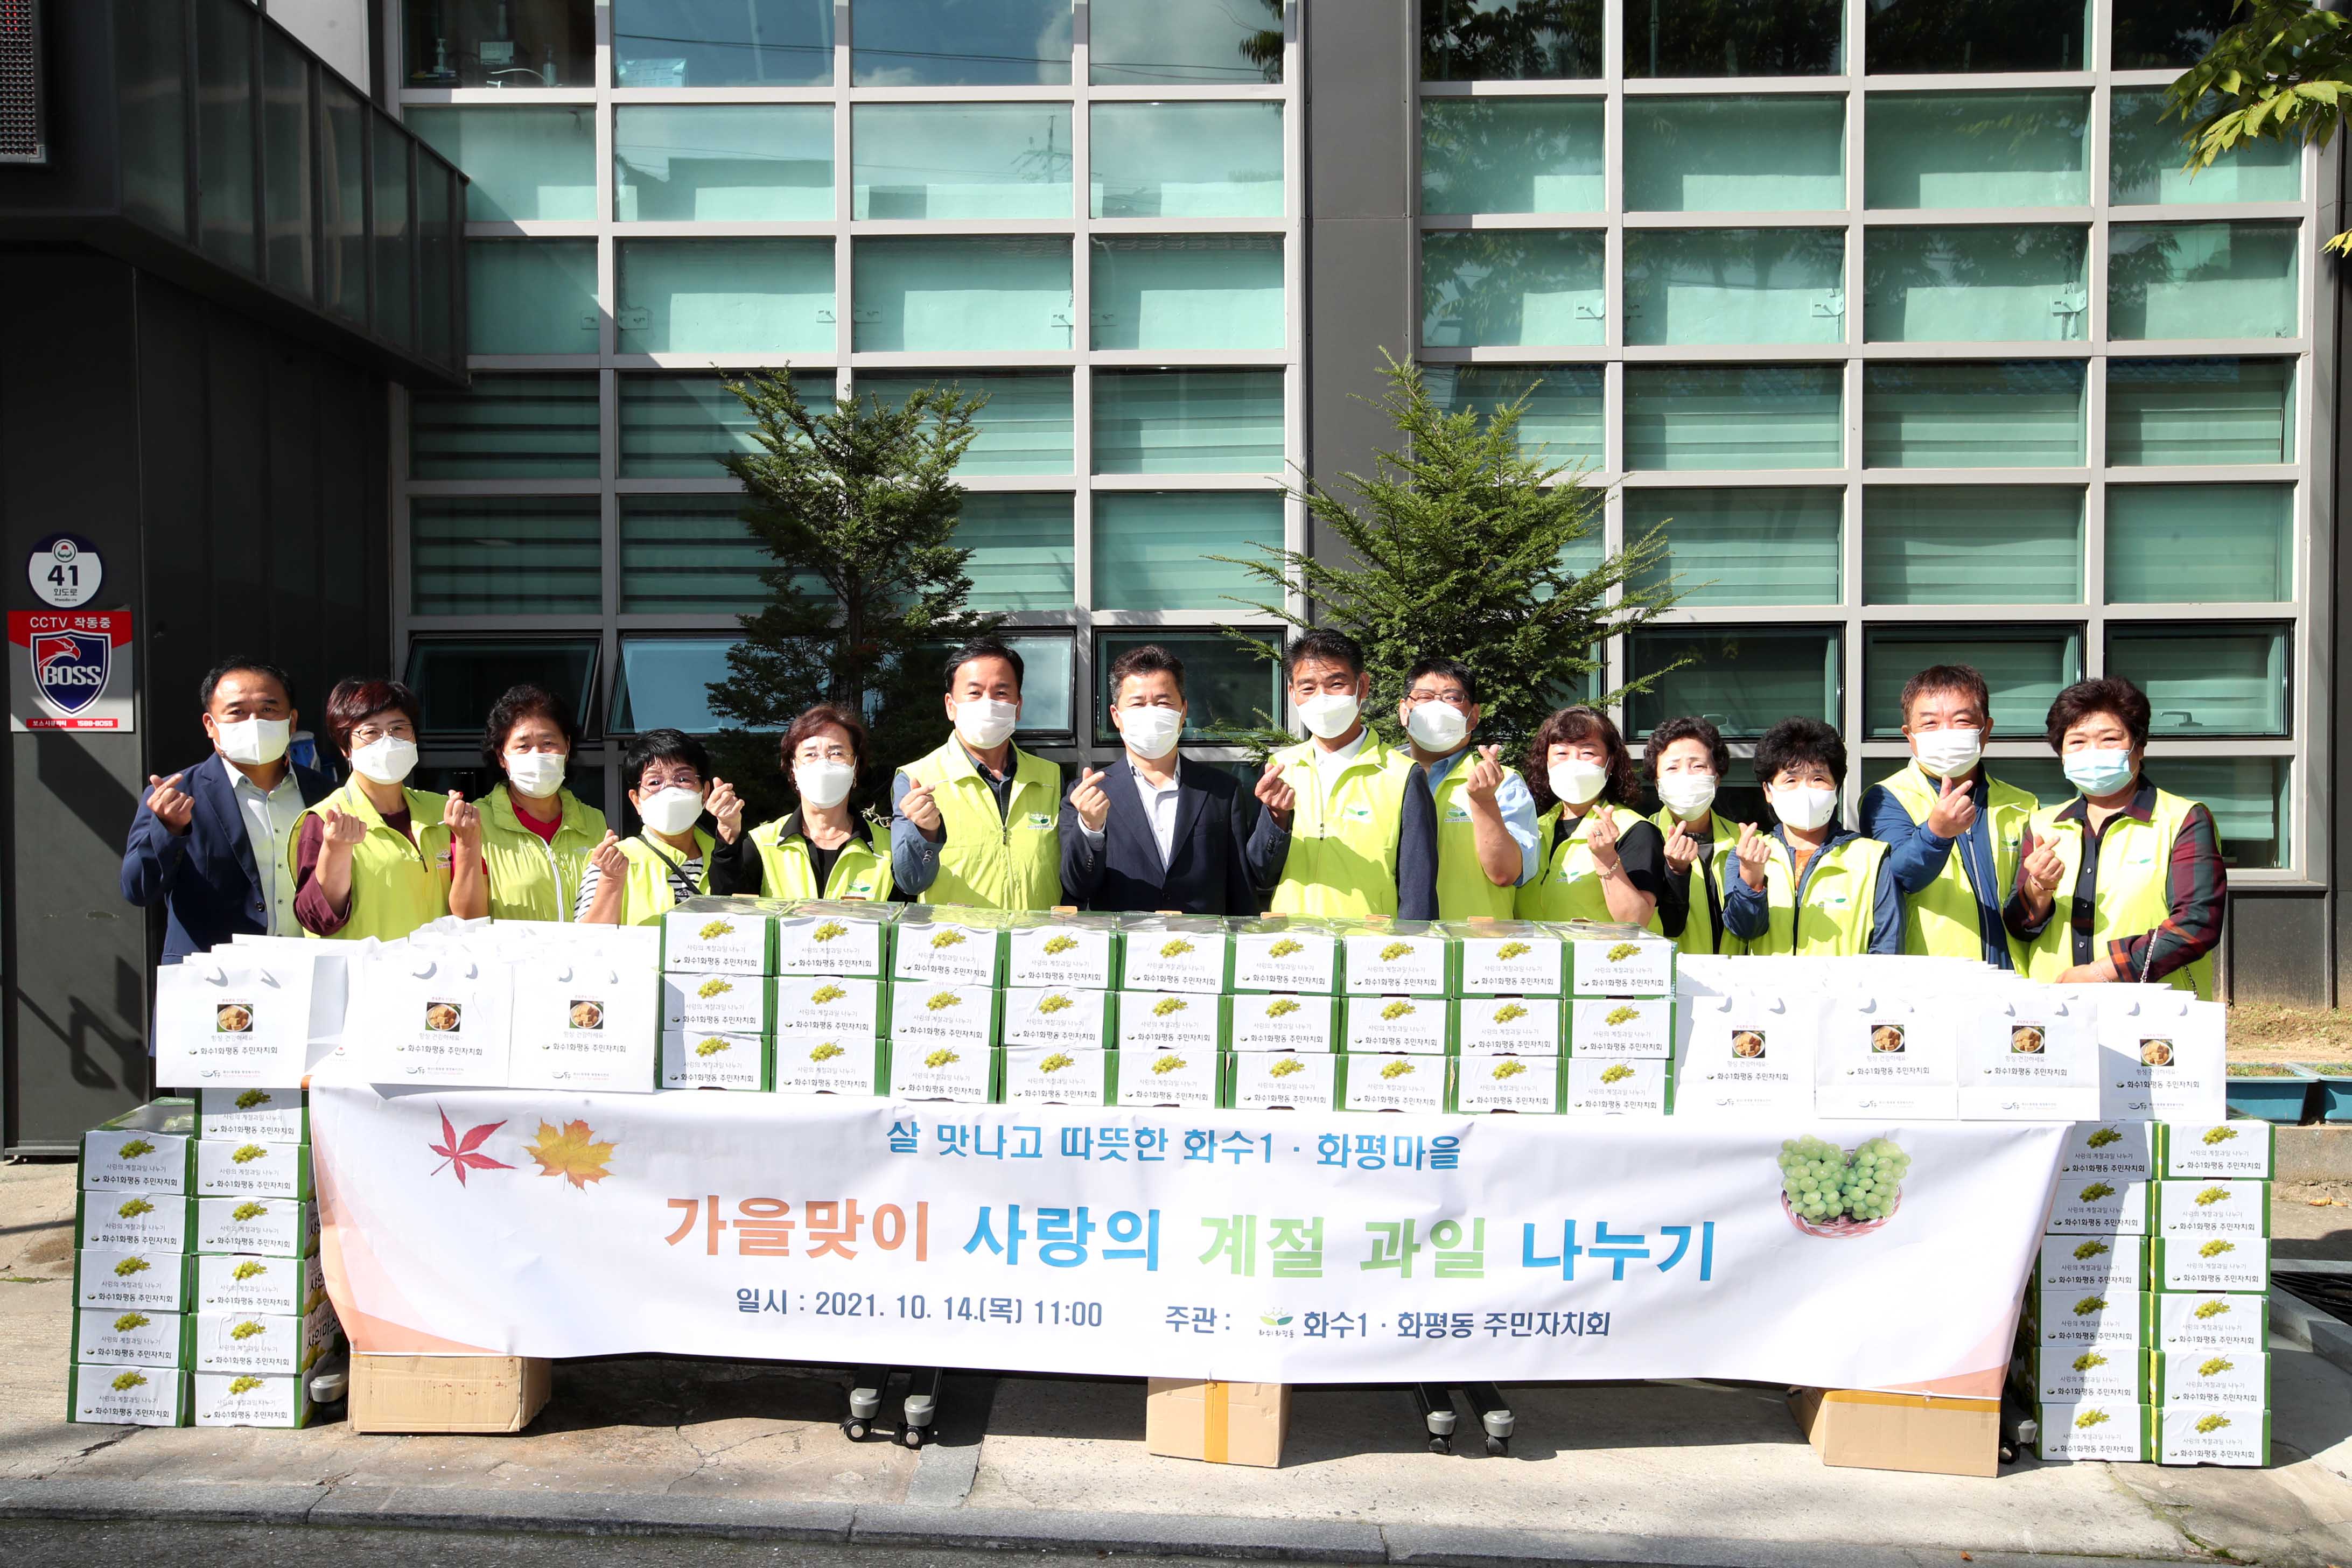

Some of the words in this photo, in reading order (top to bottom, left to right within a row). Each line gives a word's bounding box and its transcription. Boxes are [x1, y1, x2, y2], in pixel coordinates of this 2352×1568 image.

[47, 565, 78, 586] 41
[30, 617, 68, 628] CCTV
[74, 617, 111, 628] 작동중
[43, 666, 101, 685] BOSS
[723, 958, 757, 968] 주민자치회
[838, 960, 872, 968] 주민자치회
[953, 967, 986, 978] 주민자치회
[1067, 972, 1101, 982] 주민자치회
[1182, 976, 1216, 986] 주민자치회
[1292, 976, 1325, 985] 주민자치회
[1404, 978, 1437, 987] 주민자치회
[1520, 977, 1553, 986] 주민자치회
[1630, 979, 1664, 988] 주민자치회
[242, 1046, 277, 1055] 주민자치회
[447, 1046, 482, 1056] 주민자치회
[593, 1044, 626, 1053] 주민자치회
[1896, 1067, 1929, 1075] 주민자치회
[2033, 1068, 2067, 1076] 주민자치회
[720, 1074, 754, 1083] 주민자치회
[1755, 1073, 1788, 1081] 주민자치회
[834, 1080, 867, 1089] 주민자치회
[2166, 1081, 2200, 1089] 주민자치회
[947, 1086, 981, 1096] 주민자치회
[1063, 1090, 1097, 1099] 주민자치회
[1175, 1092, 1208, 1101] 주민자치회
[1293, 1095, 1326, 1104] 주민자치회
[1403, 1097, 1436, 1106] 주민자치회
[1515, 1097, 1549, 1105] 주민자치회
[1623, 1101, 1657, 1110] 주민자치회
[220, 1125, 257, 1135] 화수1화평동
[260, 1126, 294, 1136] 주민자치회
[886, 1121, 921, 1153] 살
[937, 1124, 1042, 1160] 맛나고
[1061, 1127, 1168, 1161] 따뜻한
[1184, 1129, 1272, 1164] 화수1
[1317, 1133, 1460, 1171] 화평마을
[2071, 1164, 2109, 1173] 화수1화평동
[2110, 1164, 2145, 1173] 주민자치회
[2187, 1161, 2224, 1170] 화수1화평동
[2227, 1162, 2261, 1170] 주민자치회
[102, 1174, 141, 1186] 화수1화평동
[143, 1177, 178, 1187] 주민자치회
[216, 1179, 254, 1189] 화수1화평동
[256, 1181, 291, 1190] 주민자치회
[2064, 1218, 2102, 1227] 화수1화평동
[2103, 1219, 2138, 1227] 주민자치회
[2179, 1222, 2217, 1231] 화수1화평동
[2220, 1223, 2255, 1232] 주민자치회
[101, 1234, 139, 1244] 화수1화평동
[142, 1236, 177, 1246] 주민자치회
[217, 1236, 255, 1247] 화수1화평동
[257, 1238, 290, 1248] 주민자치회
[664, 1195, 928, 1261] 가을맞이
[963, 1204, 1160, 1271] 사랑의
[1199, 1215, 1324, 1278] 계절
[1360, 1217, 1485, 1278] 과일
[1522, 1219, 1714, 1282] 나누기
[2058, 1275, 2096, 1285] 화수1화평동
[2097, 1276, 2132, 1285] 주민자치회
[2183, 1274, 2221, 1283] 화수1화평동
[2223, 1275, 2259, 1284] 주민자치회
[98, 1292, 136, 1303] 화수1화평동
[138, 1294, 173, 1304] 주민자치회
[217, 1296, 254, 1306] 화수1화평동
[256, 1298, 290, 1307] 주민자치회
[737, 1289, 787, 1314] 일시
[816, 1292, 884, 1317] 2021.
[897, 1295, 930, 1319] 10.
[1035, 1300, 1102, 1327] 11:00
[1166, 1306, 1217, 1333] 주관
[1304, 1312, 1366, 1338] 화수1
[1398, 1312, 1474, 1339] 화평동
[1483, 1312, 1610, 1338] 주민자치회
[307, 1317, 340, 1349] 샤인마스
[2058, 1331, 2097, 1341] 화수1화평동
[2097, 1332, 2132, 1340] 주민자치회
[2179, 1335, 2217, 1344] 화수1화평동
[2219, 1336, 2254, 1345] 주민자치회
[97, 1348, 135, 1358] 화수1화평동
[137, 1349, 172, 1360] 주민자치회
[215, 1356, 253, 1366] 화수1화평동
[255, 1357, 289, 1366] 주민자치회
[2057, 1387, 2094, 1396] 화수1화평동
[2097, 1388, 2131, 1396] 주민자치회
[2182, 1392, 2220, 1402] 화수1화평동
[2222, 1393, 2257, 1403] 주민자치회
[95, 1406, 133, 1417] 화수1화평동
[134, 1409, 170, 1419] 주민자치회
[213, 1410, 251, 1419] 화수1화평동
[254, 1411, 288, 1420] 주민자치회
[2060, 1444, 2097, 1453] 화수1화평동
[2099, 1445, 2133, 1453] 주민자치회
[2180, 1449, 2217, 1459] 화수1화평동
[2220, 1450, 2255, 1459] 주민자치회
